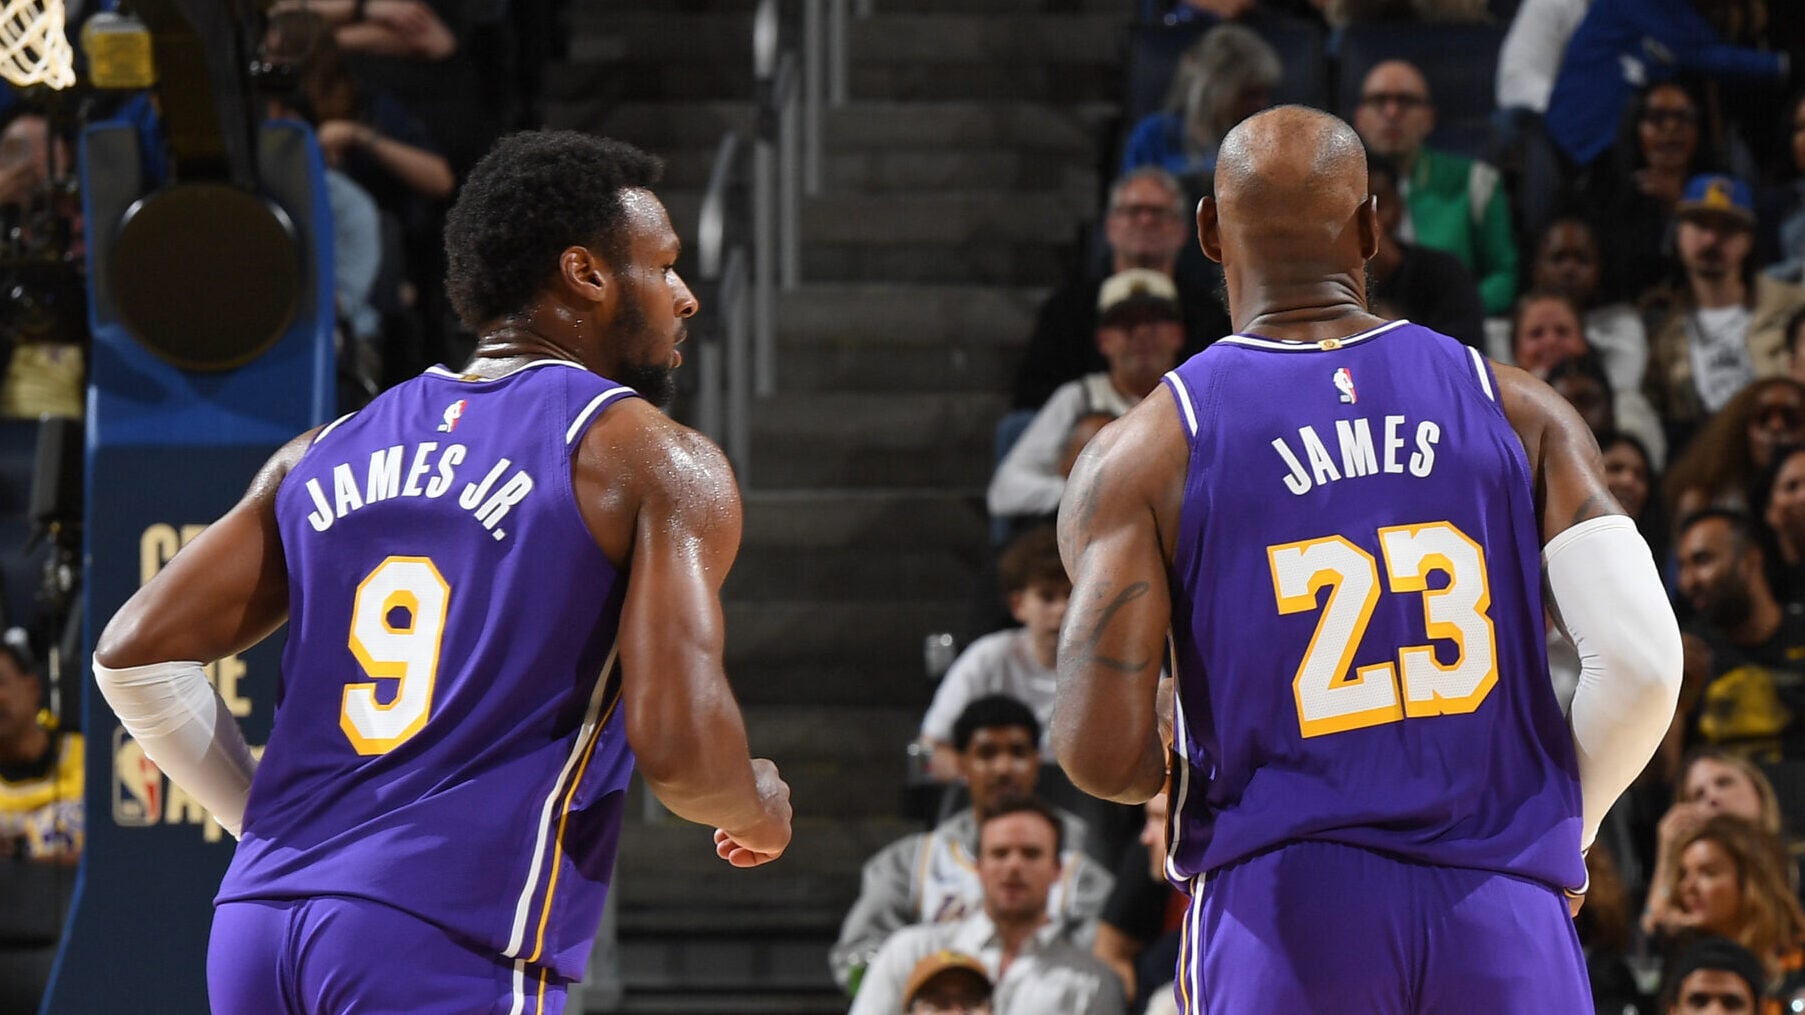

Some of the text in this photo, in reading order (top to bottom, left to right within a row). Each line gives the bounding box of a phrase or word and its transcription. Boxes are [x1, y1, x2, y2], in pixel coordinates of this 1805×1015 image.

[305, 442, 534, 541] JAMES JR.
[1271, 415, 1441, 495] JAMES
[339, 555, 450, 756] 9
[1266, 520, 1499, 739] 23
